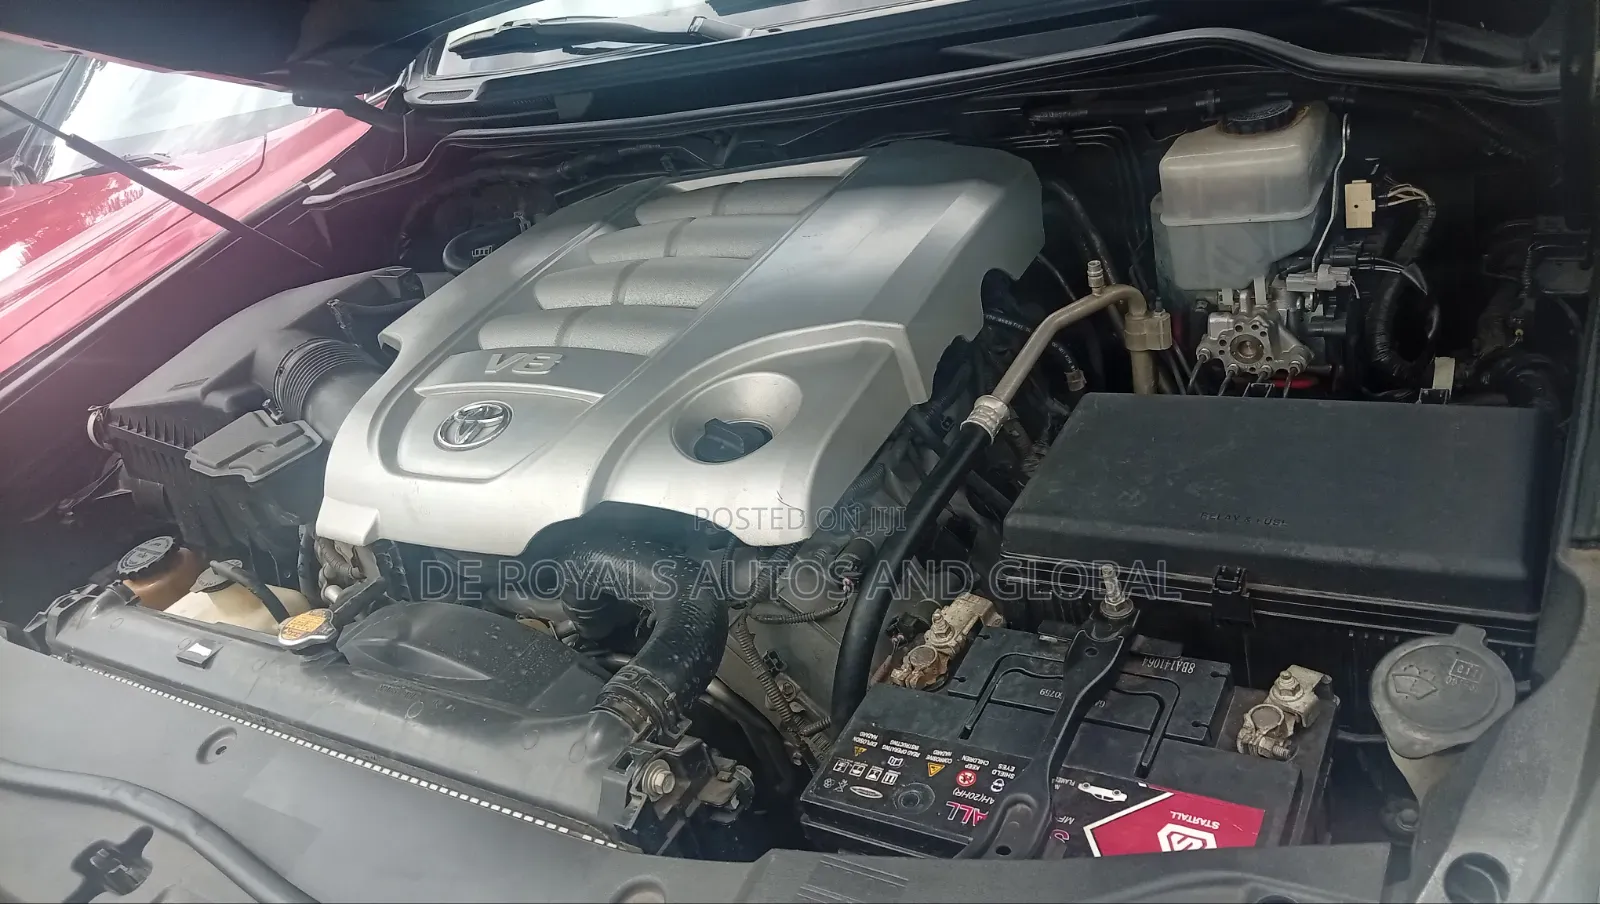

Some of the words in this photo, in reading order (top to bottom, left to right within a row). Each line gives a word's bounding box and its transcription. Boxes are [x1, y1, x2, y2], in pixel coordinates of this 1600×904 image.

[485, 352, 563, 375] V8
[961, 754, 990, 765] CHILDREN
[964, 763, 981, 771] KEEP
[997, 763, 1016, 772] EYES
[991, 768, 1016, 779] SHIELD
